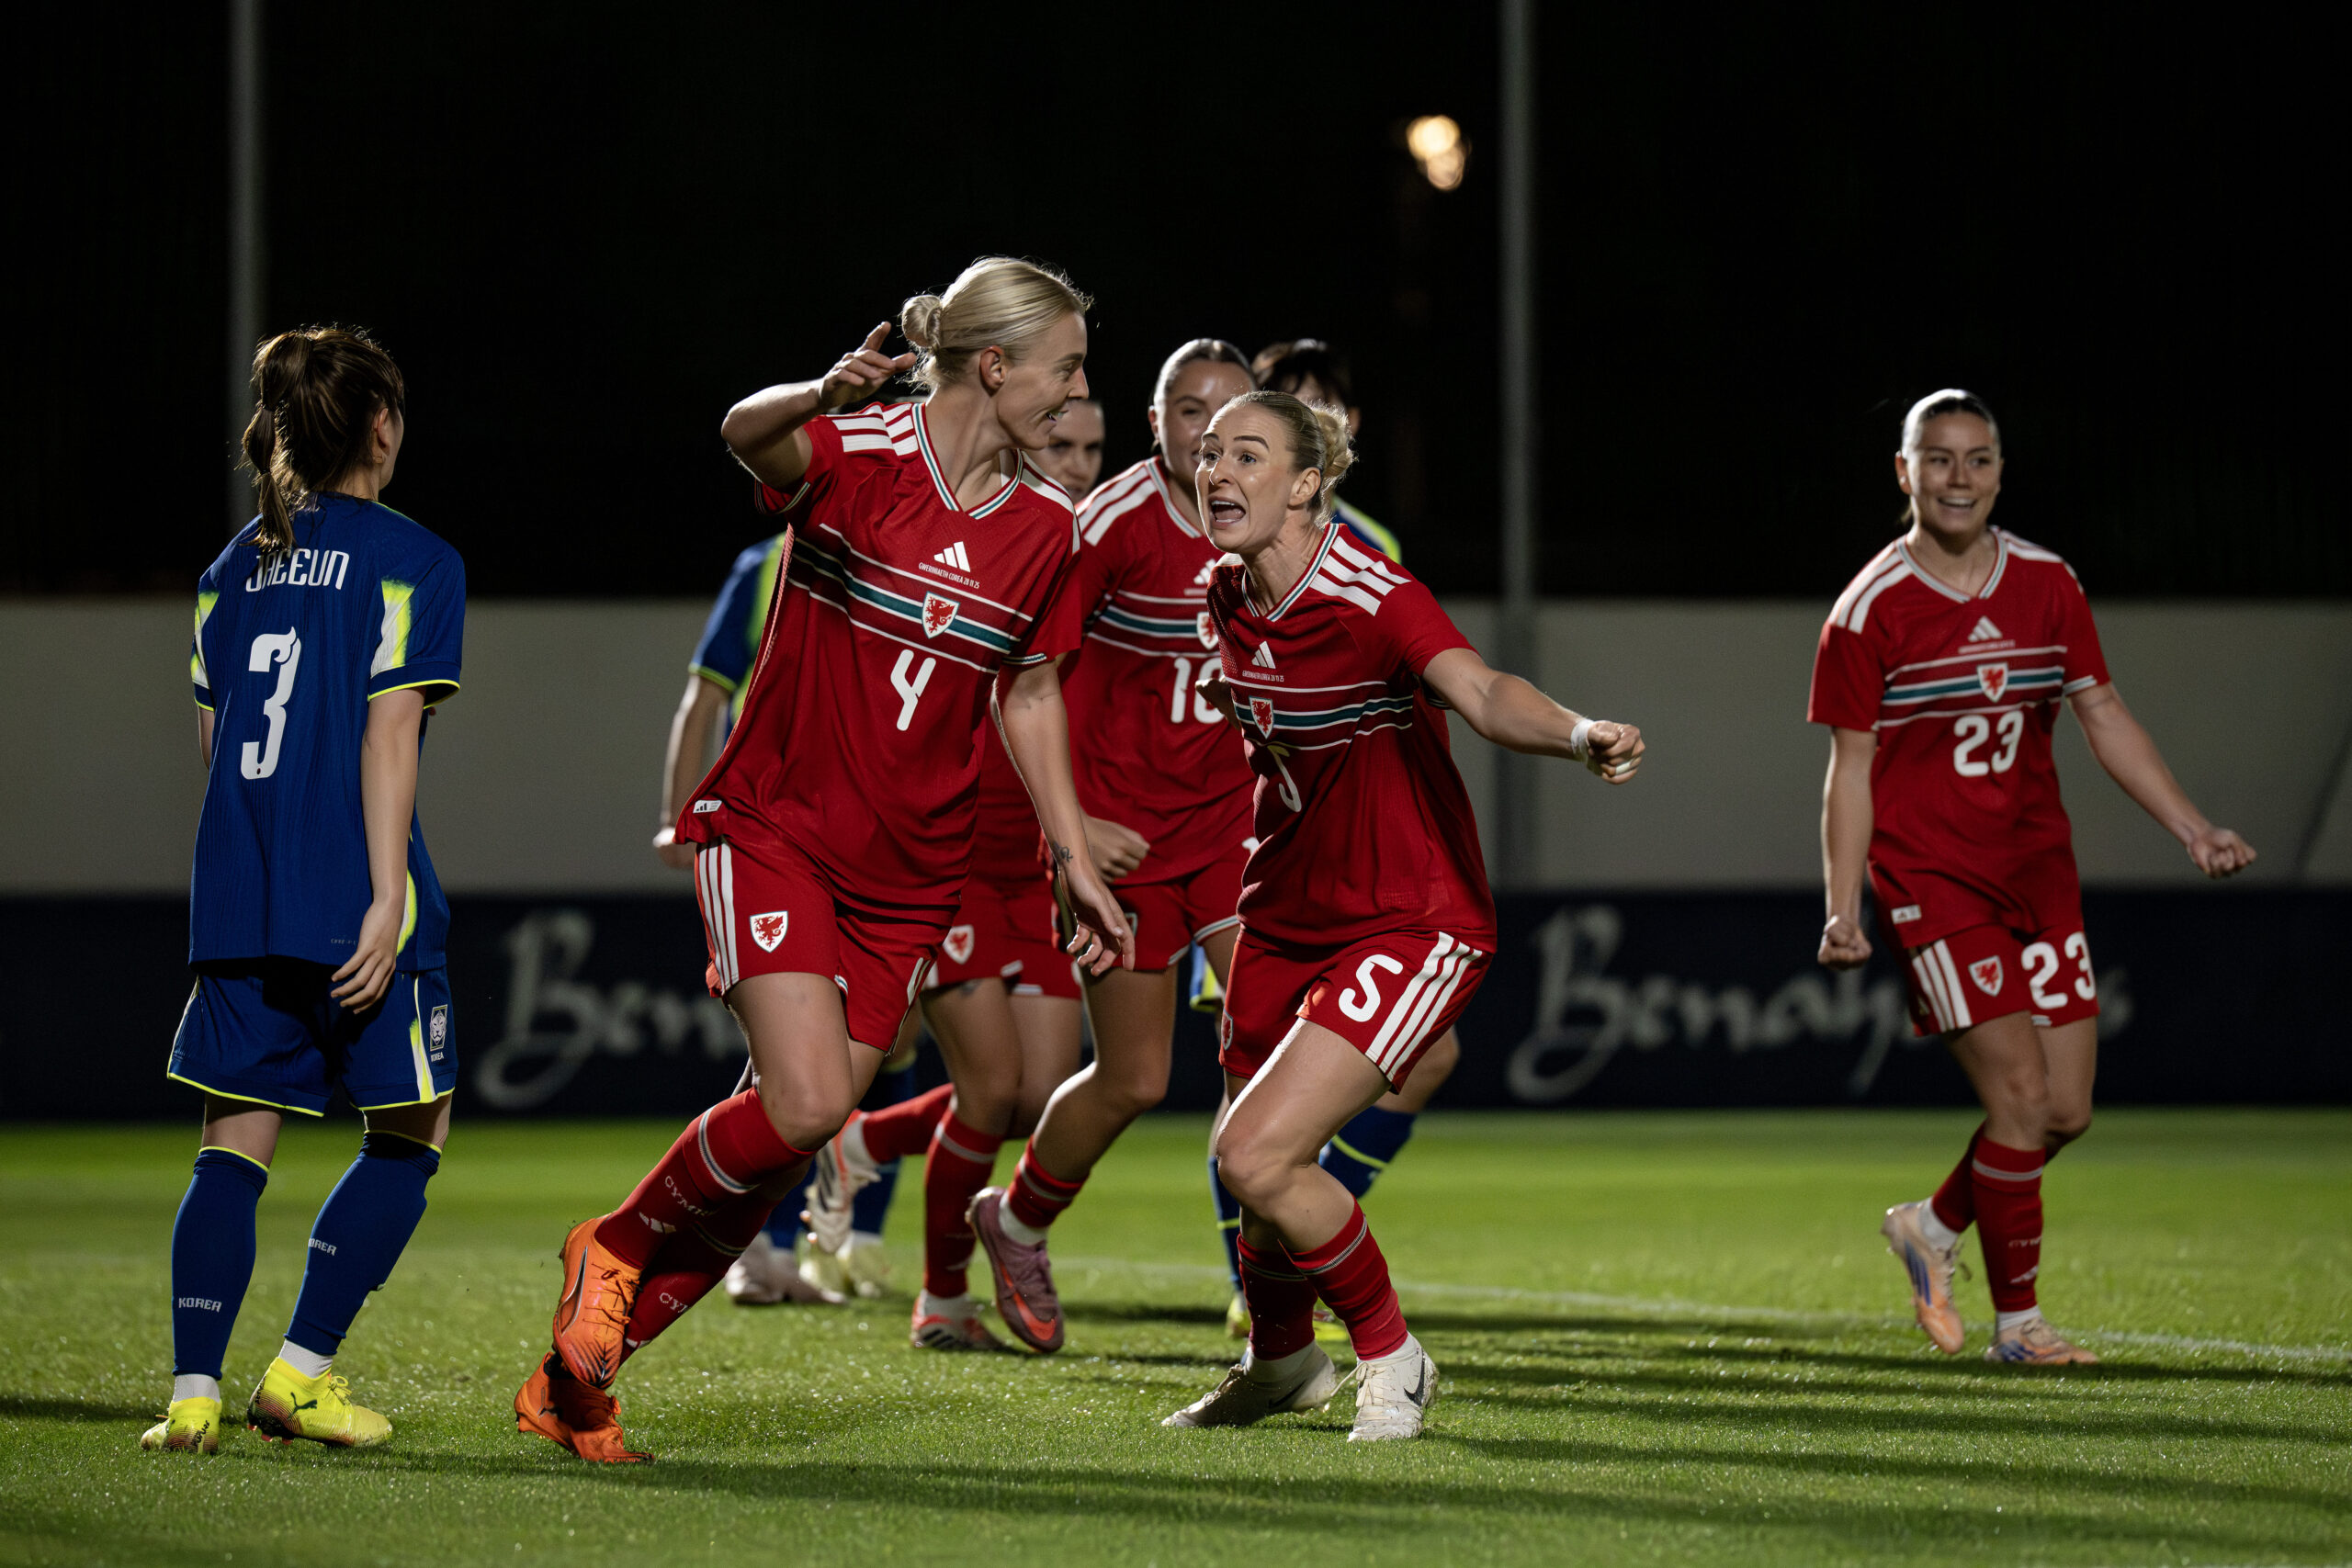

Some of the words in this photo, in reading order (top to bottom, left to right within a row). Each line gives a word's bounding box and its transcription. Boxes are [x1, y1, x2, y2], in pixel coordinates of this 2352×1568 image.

[245, 548, 349, 592] JAEEUN
[241, 626, 301, 780] 3
[890, 649, 937, 731] 4
[1953, 709, 2025, 777] 23
[2020, 931, 2097, 1010] 23
[178, 1296, 222, 1313] KOREA
